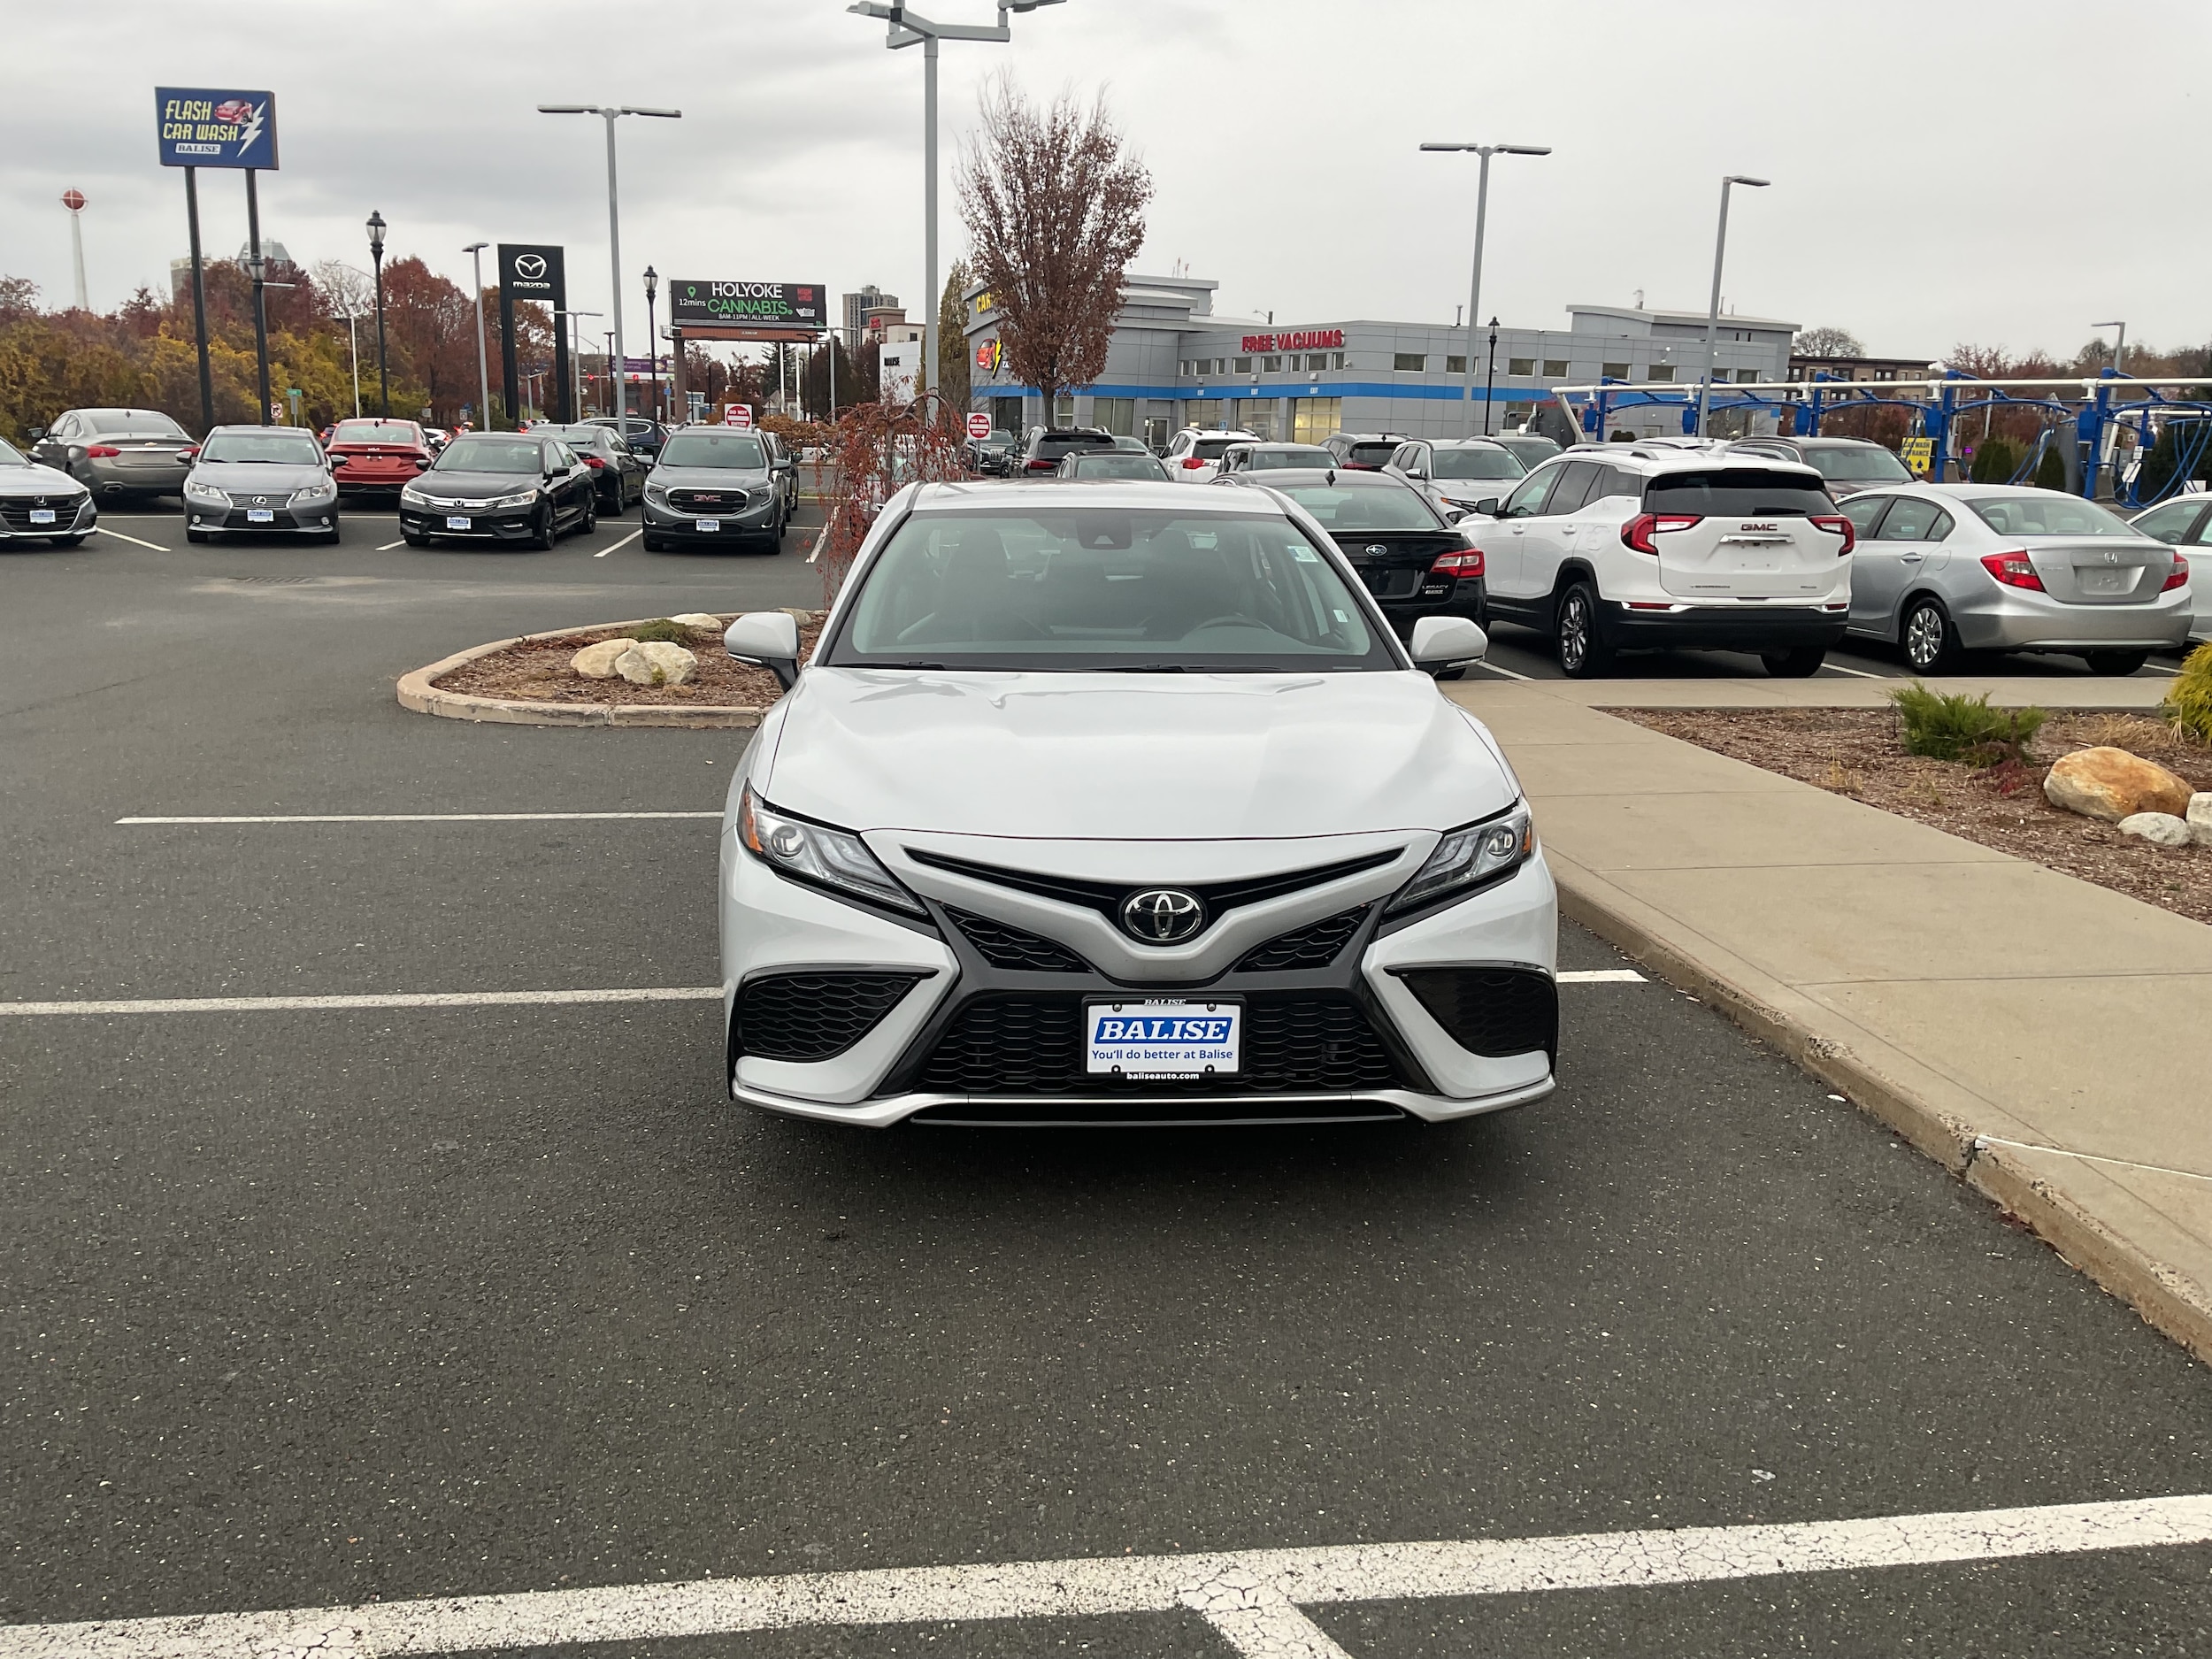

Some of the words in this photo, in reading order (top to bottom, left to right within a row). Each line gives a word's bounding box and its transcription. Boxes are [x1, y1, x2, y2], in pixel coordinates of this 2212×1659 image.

[165, 100, 211, 120] FLASH
[163, 123, 192, 140] CAR
[196, 125, 238, 141] WASH
[178, 144, 219, 153] BALISE
[711, 282, 782, 298] HOLYOKE
[679, 298, 706, 307] 12mins
[1242, 334, 1274, 352] FREE
[1277, 329, 1344, 349] VACUUMS
[1099, 1020, 1227, 1041] BALISE
[1092, 1049, 1123, 1059] You'll
[1126, 1049, 1141, 1059] do
[1144, 1049, 1179, 1059] better
[1184, 1050, 1195, 1059] at
[1199, 1049, 1233, 1059] Balise
